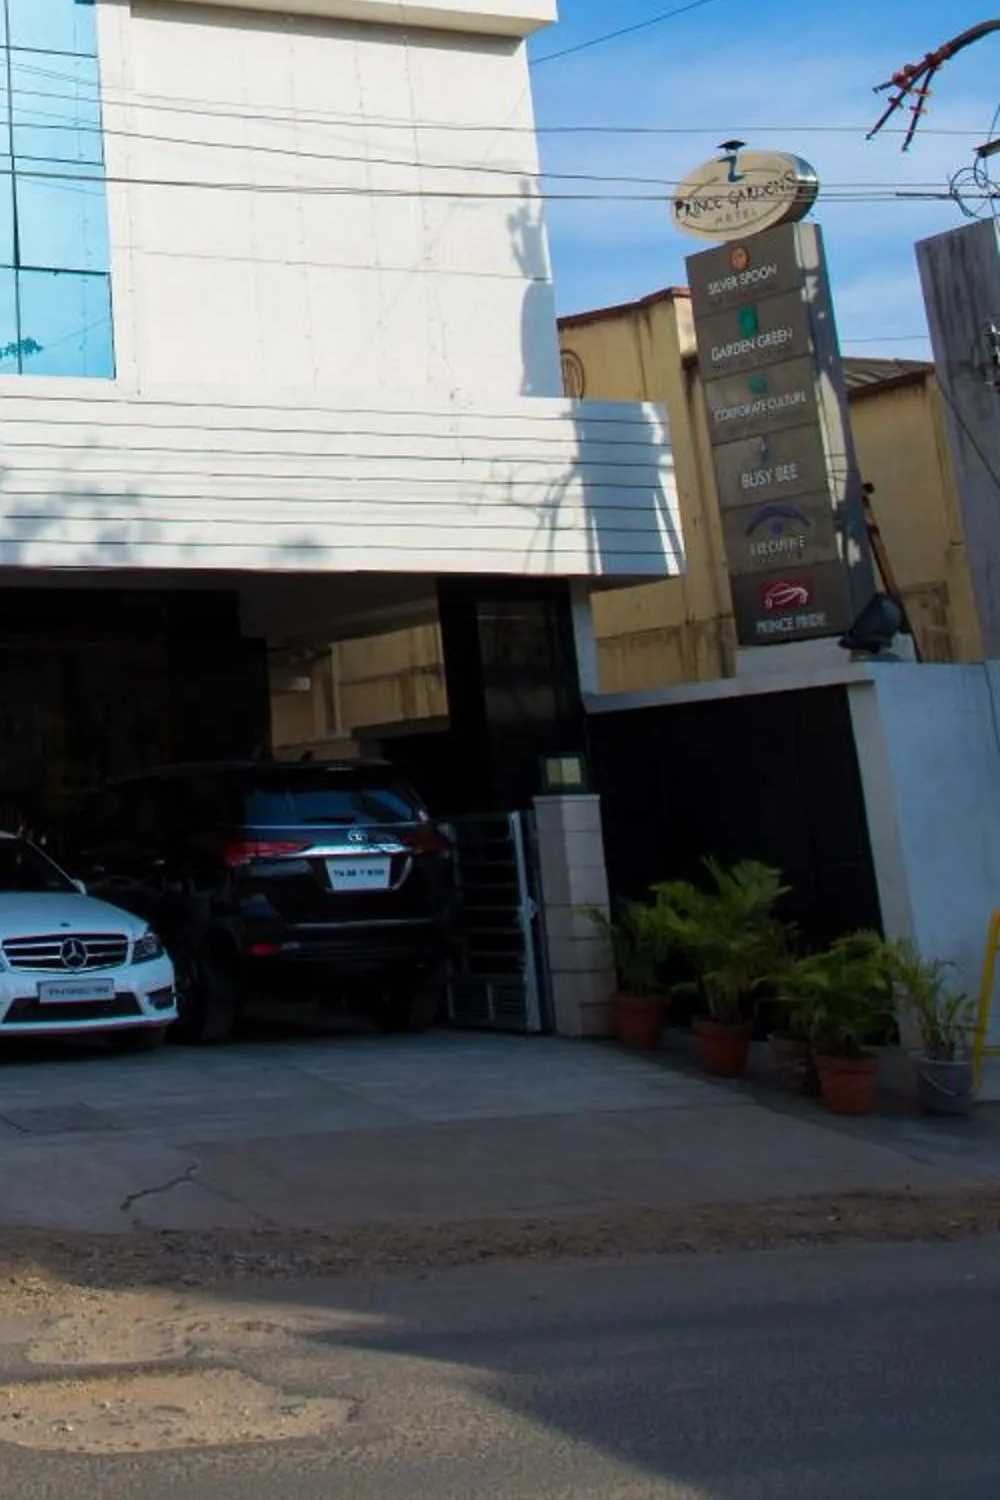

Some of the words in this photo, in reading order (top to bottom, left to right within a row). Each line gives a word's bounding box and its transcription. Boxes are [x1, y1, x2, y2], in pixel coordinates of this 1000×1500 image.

[674, 196, 722, 219] PRINCE
[739, 262, 778, 286] SPOON
[711, 339, 755, 362] GARDEN
[756, 326, 794, 349] GREEN
[741, 467, 774, 489] BUSY
[774, 462, 799, 484] BEE
